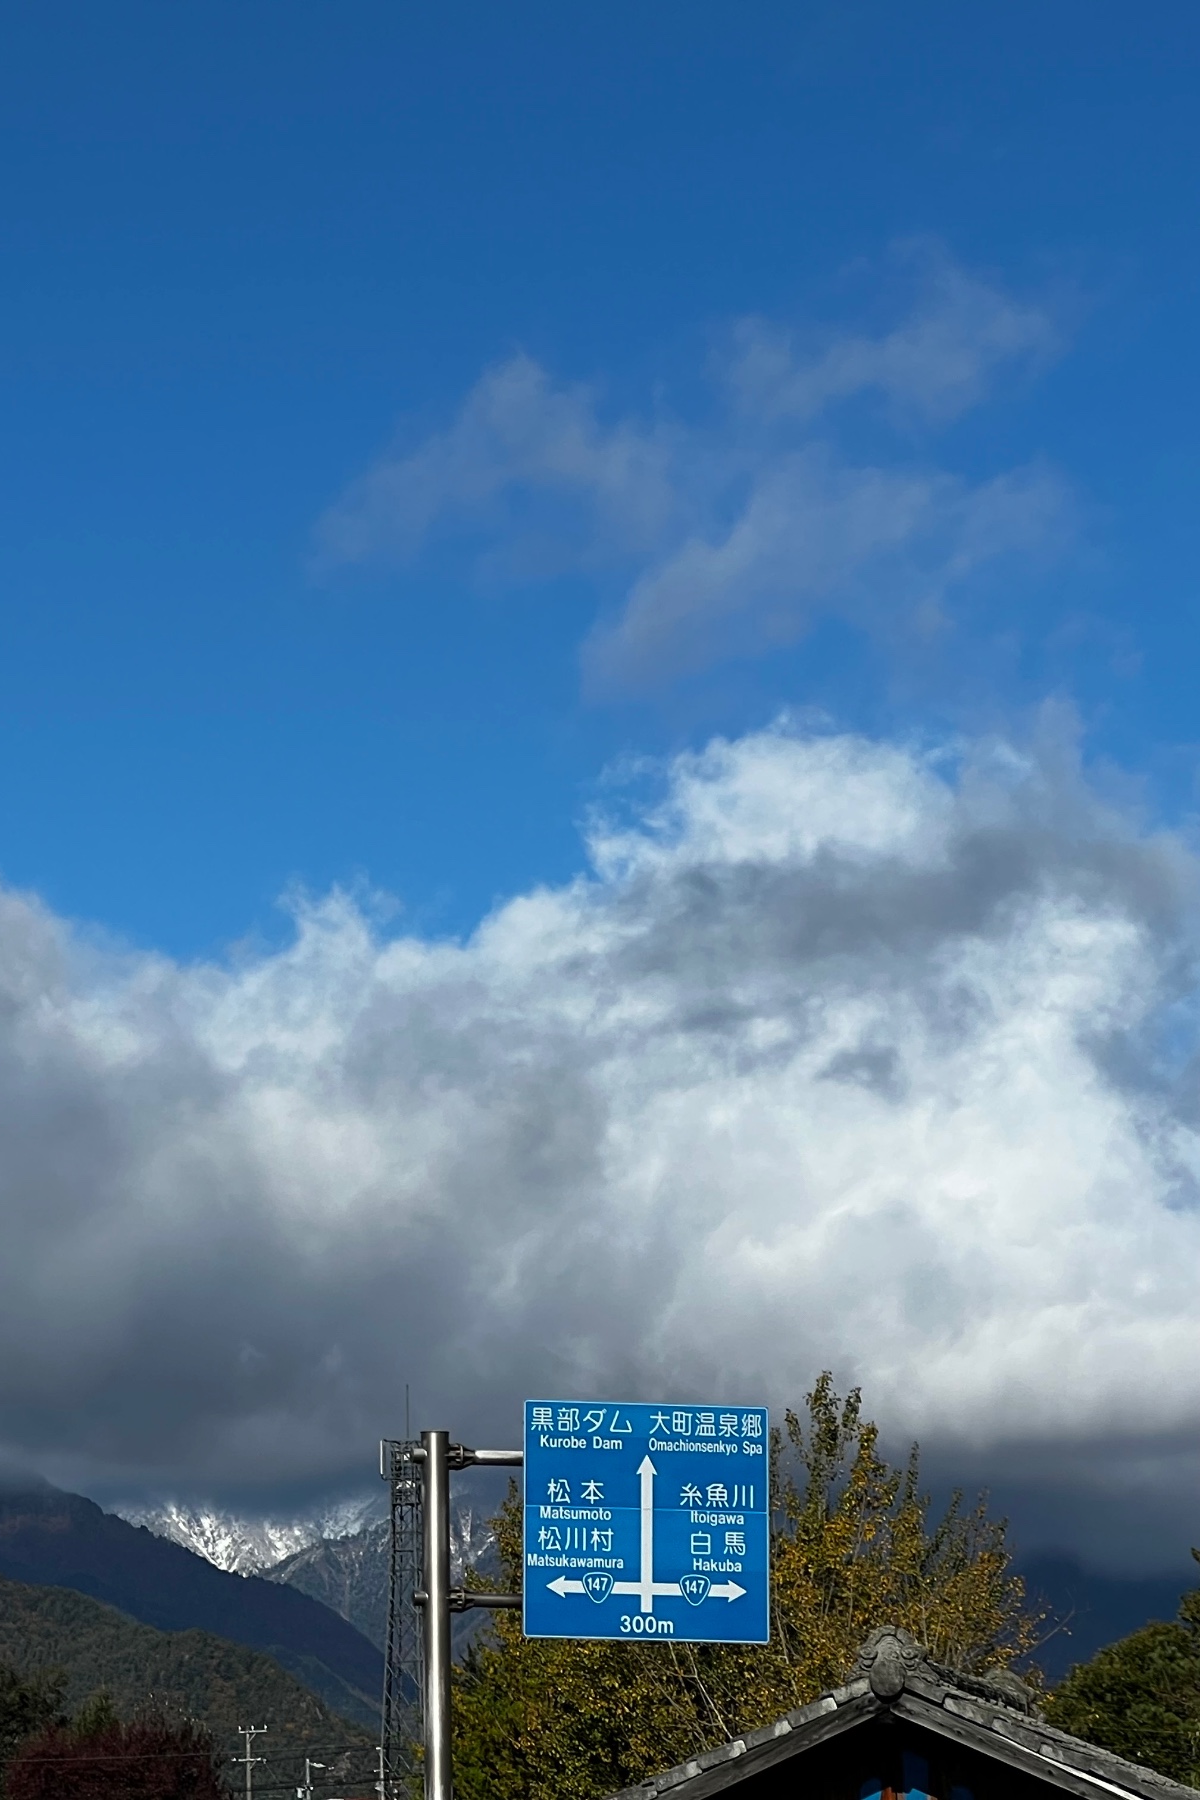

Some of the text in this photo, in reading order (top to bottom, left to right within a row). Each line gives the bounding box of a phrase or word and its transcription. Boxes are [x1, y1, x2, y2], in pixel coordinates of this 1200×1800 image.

[531, 1408, 632, 1433] 黒部ダム
[650, 1411, 762, 1438] 大町温泉郷
[540, 1435, 623, 1450] Kurobe Dam
[649, 1438, 762, 1455] Omachionsenkyo Spa
[547, 1479, 604, 1504] 松本
[680, 1483, 754, 1508] 糸魚川
[540, 1507, 611, 1520] Matsumoto
[691, 1512, 744, 1526] Itoigawa
[538, 1526, 613, 1551] 松川村
[691, 1531, 746, 1556] 白馬
[527, 1554, 624, 1568] Matsukawamura
[693, 1559, 742, 1572] Hakuba
[588, 1578, 606, 1591] 147
[685, 1580, 704, 1594] 147
[620, 1616, 674, 1633] 300m
